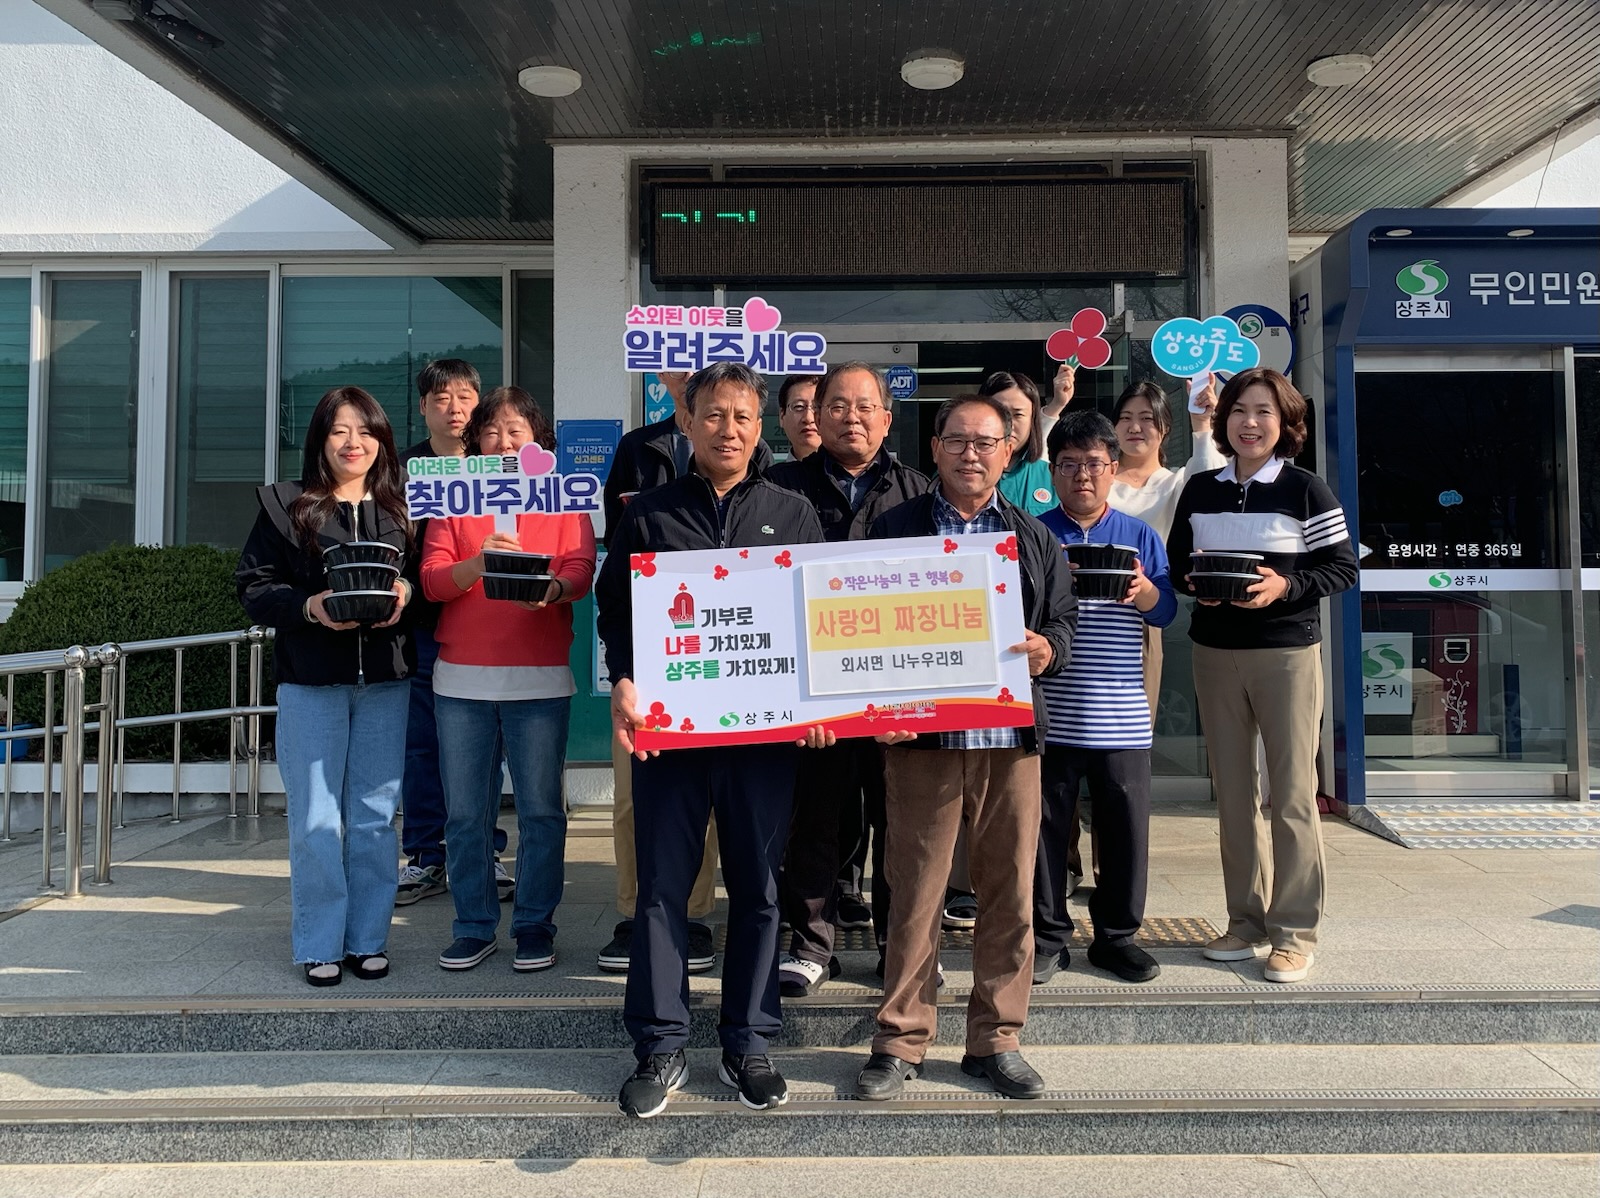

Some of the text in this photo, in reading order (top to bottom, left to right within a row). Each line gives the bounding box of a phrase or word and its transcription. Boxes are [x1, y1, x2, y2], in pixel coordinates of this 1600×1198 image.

[627, 307, 743, 327] 소외된 이웃을
[1397, 302, 1449, 317] 상주시
[625, 330, 825, 372] 알려주세요
[1162, 327, 1244, 363] 상상주도
[1171, 359, 1205, 371] SANGJU
[889, 376, 913, 389] ADT
[566, 445, 613, 455] 복지사각지대
[574, 455, 605, 464] 신고센터
[409, 456, 519, 476] 어려운 이웃을
[408, 476, 599, 517] 찾아주세요
[1387, 543, 1437, 557] 운영시간
[1455, 543, 1480, 557] 연중
[1484, 543, 1522, 557] 365일
[844, 570, 949, 591] 작은나눔의 큰 행복
[1454, 575, 1488, 586] 상주시
[700, 606, 754, 628] 기부로
[815, 602, 983, 638] 사랑의 짜장나눔
[665, 632, 771, 656] 나를 가치있게
[665, 657, 796, 681] 상주를 가치있게!
[841, 650, 963, 673] 외서면 나누우리회
